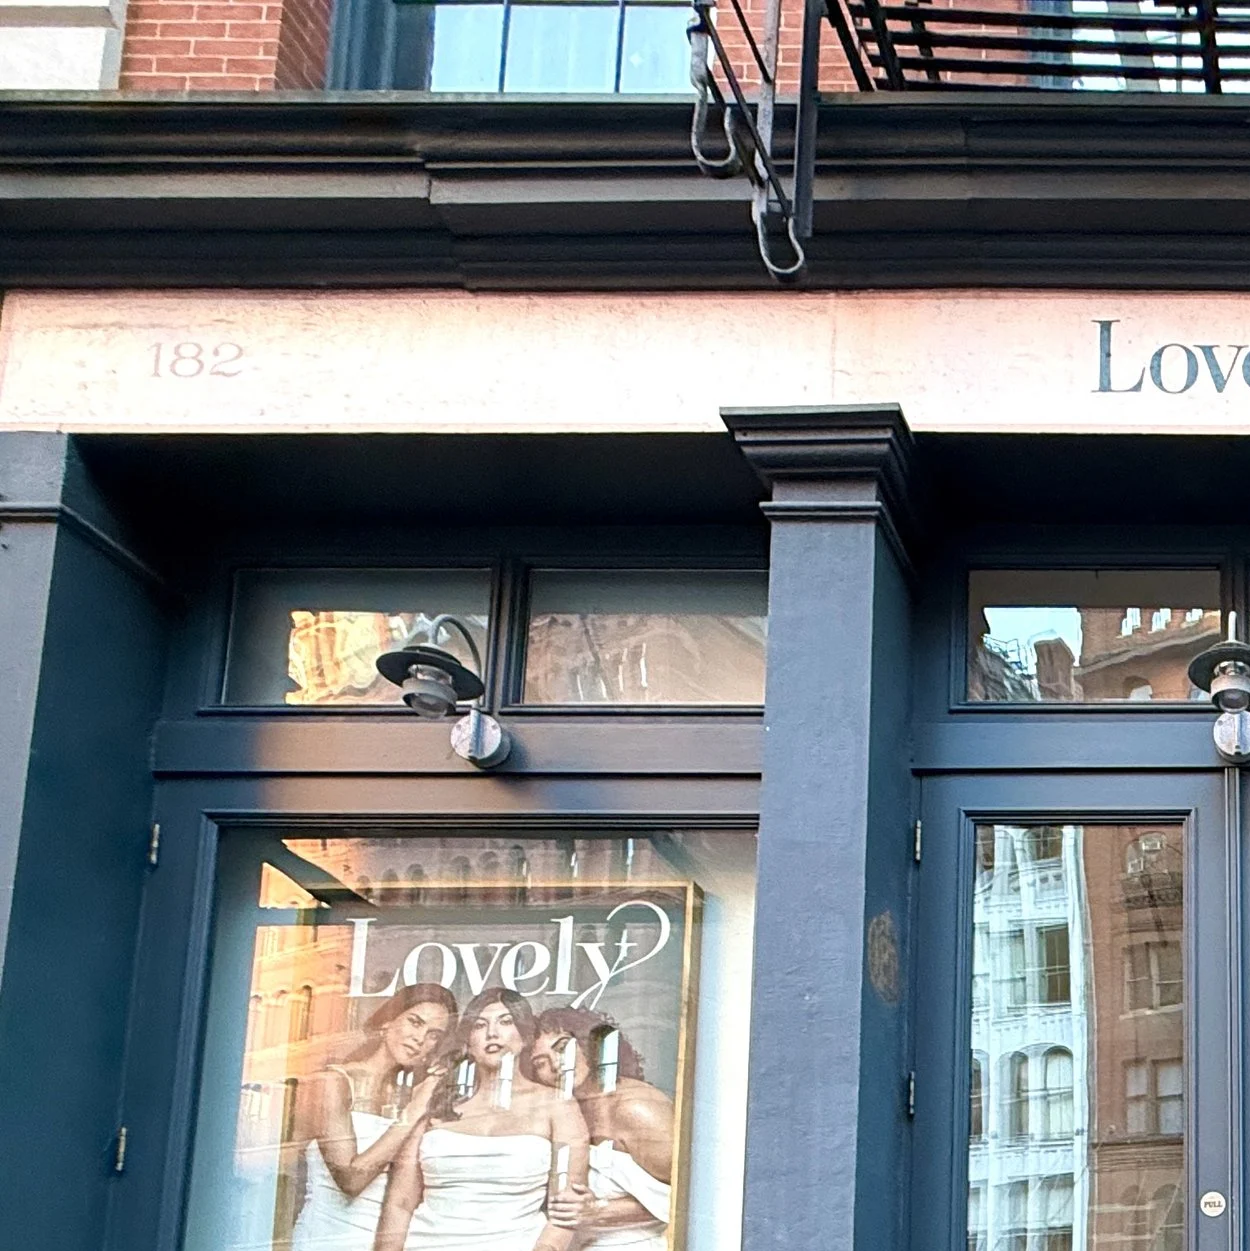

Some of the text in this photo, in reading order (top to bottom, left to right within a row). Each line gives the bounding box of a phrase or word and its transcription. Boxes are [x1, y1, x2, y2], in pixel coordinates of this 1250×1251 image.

[147, 341, 244, 378] 182
[338, 900, 672, 1011] Lovely
[1203, 1200, 1224, 1209] PULL
